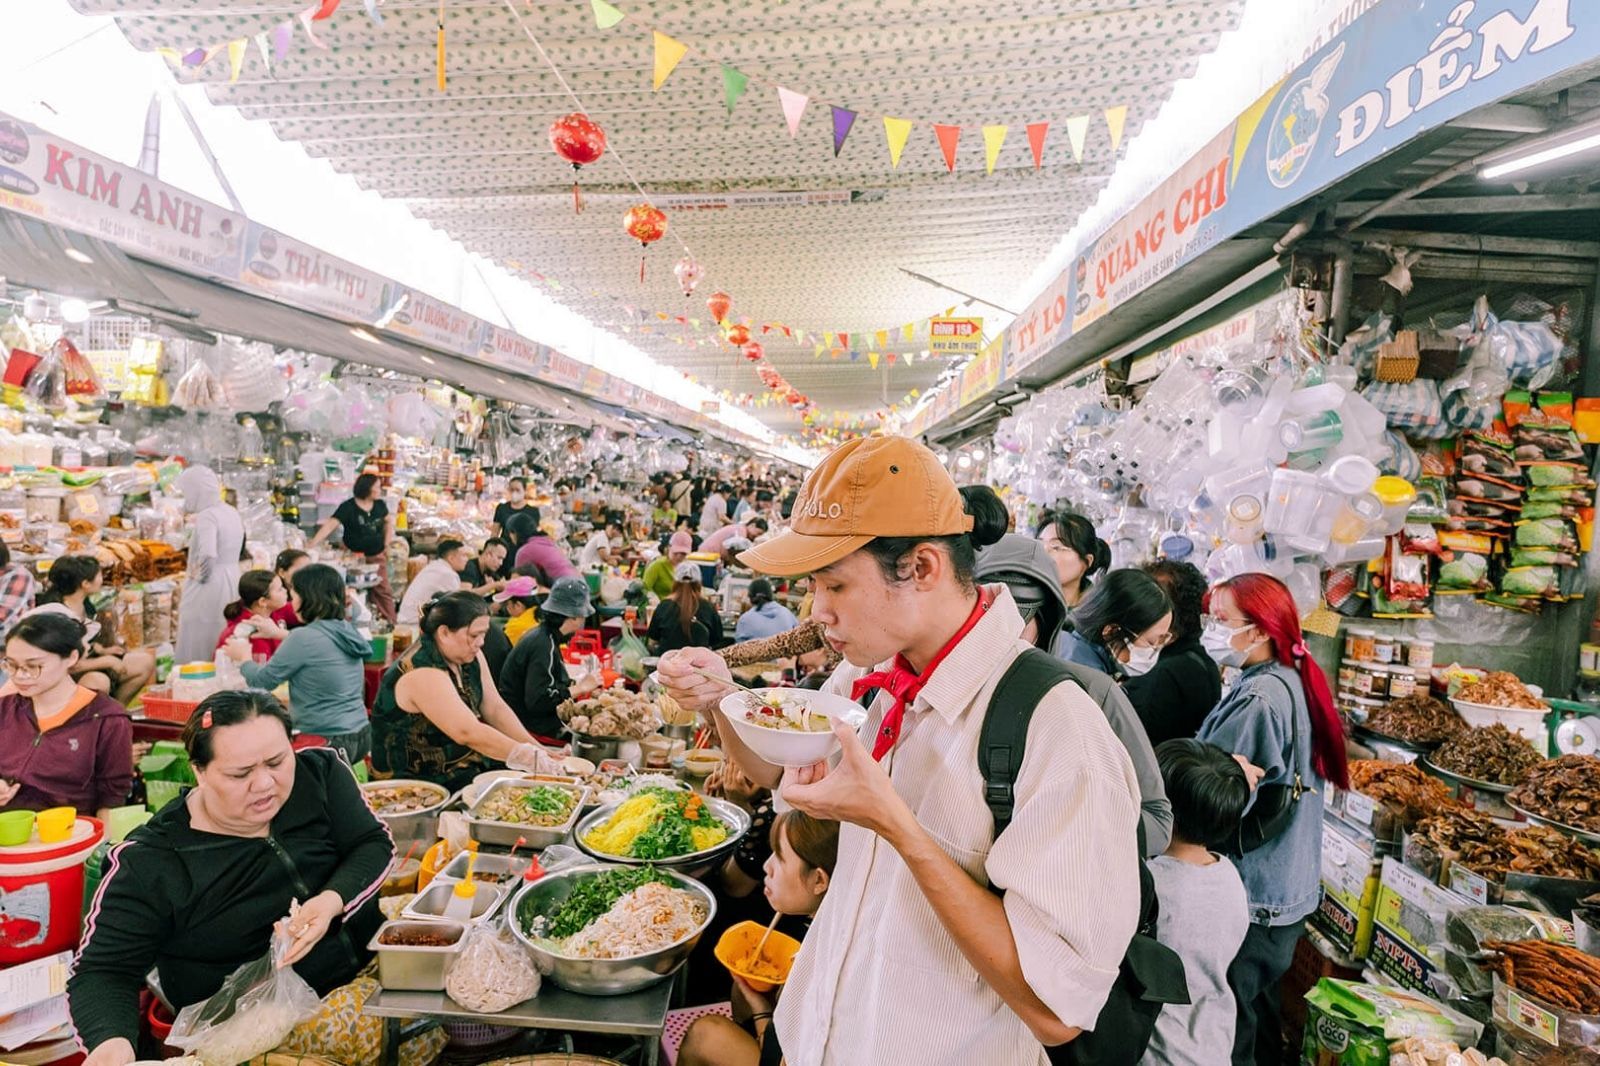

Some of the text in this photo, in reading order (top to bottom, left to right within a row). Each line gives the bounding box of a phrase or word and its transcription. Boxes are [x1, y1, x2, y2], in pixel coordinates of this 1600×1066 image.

[1334, 0, 1576, 157] ĐIỂM
[43, 143, 122, 208] KIM
[130, 183, 204, 239] ANH
[1095, 208, 1166, 299] QUANG
[1172, 155, 1231, 235] CHI
[1319, 1024, 1346, 1041] COCO
